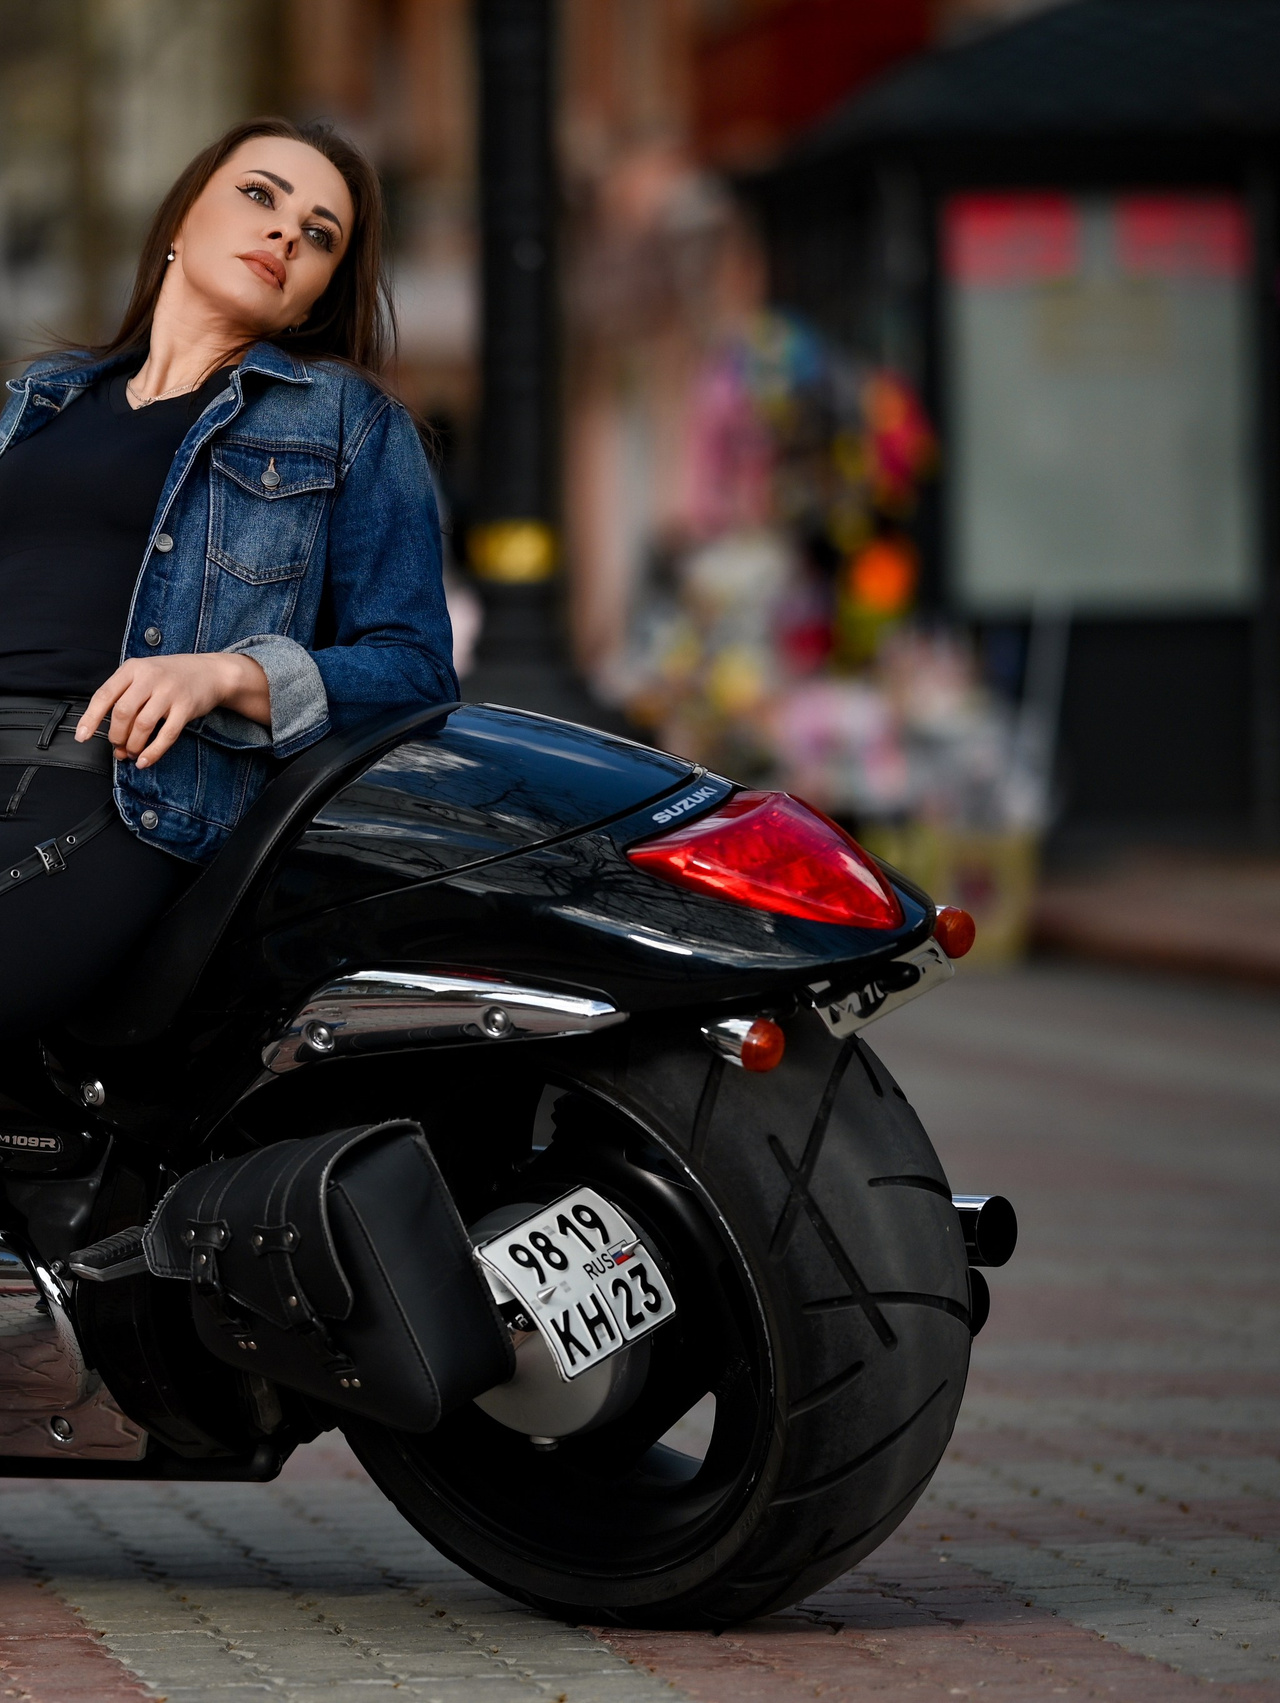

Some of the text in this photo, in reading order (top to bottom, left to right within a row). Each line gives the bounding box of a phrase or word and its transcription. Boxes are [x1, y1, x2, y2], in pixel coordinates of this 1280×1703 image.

[652, 786, 718, 824] SUZUKI
[583, 1253, 615, 1280] RUS
[550, 1263, 662, 1366] KH 23
